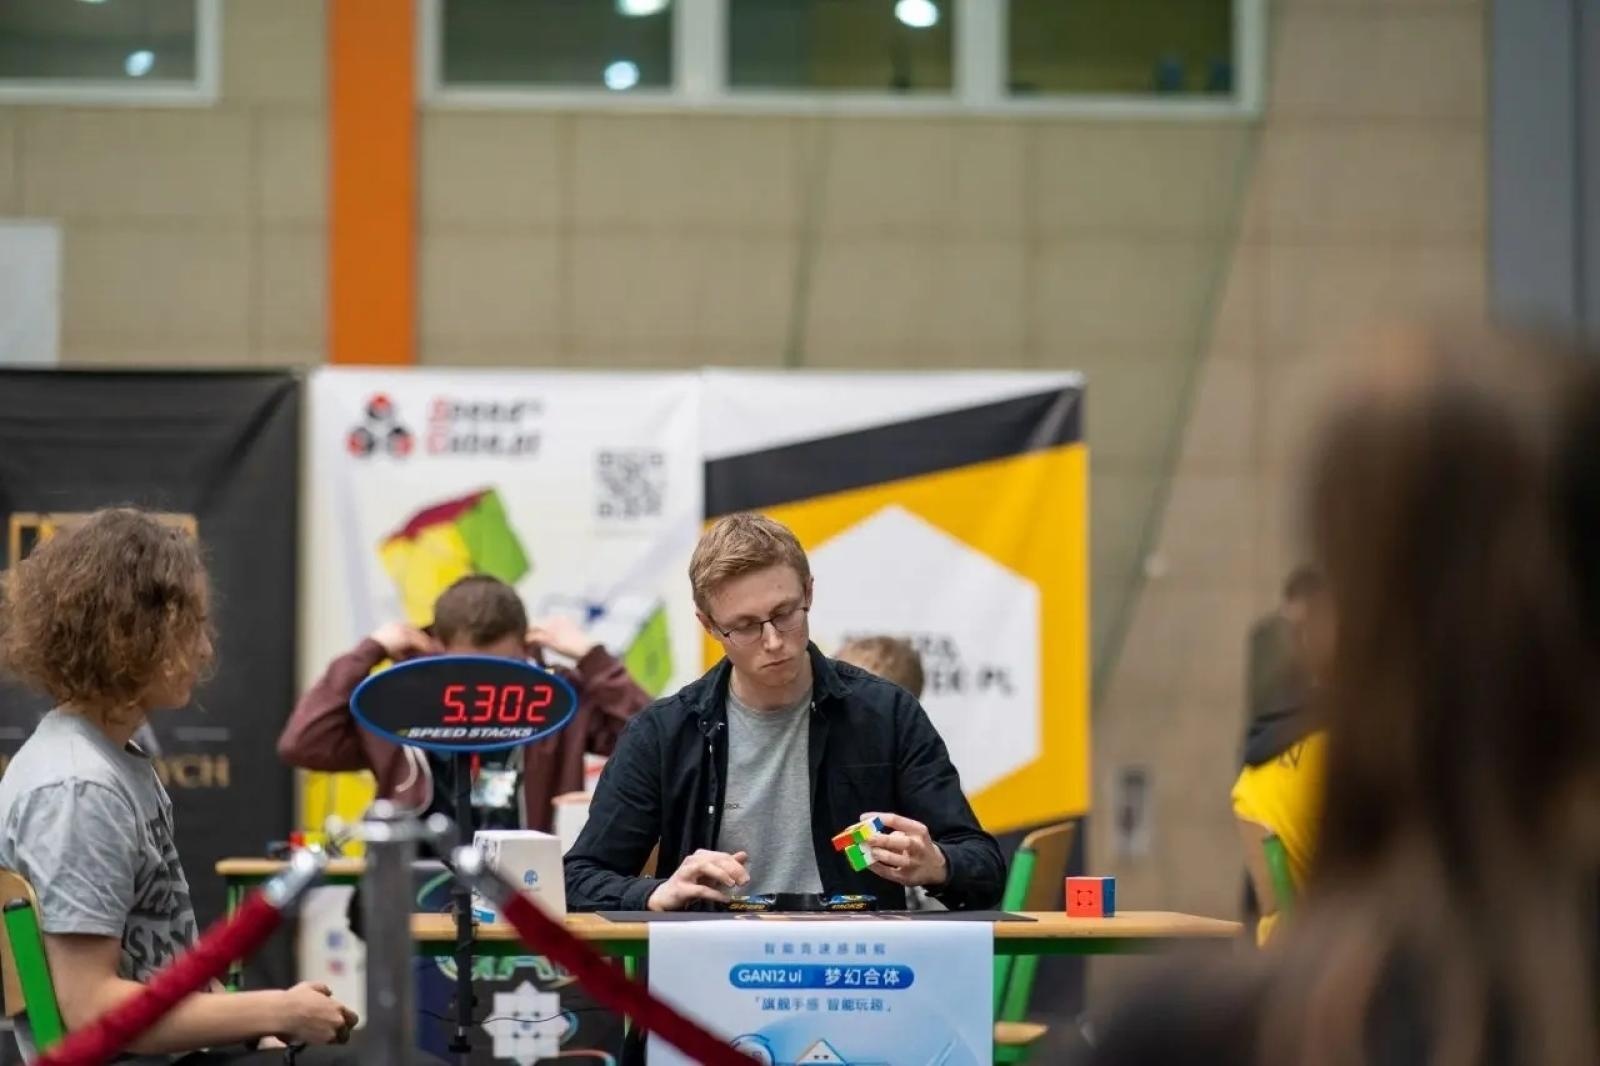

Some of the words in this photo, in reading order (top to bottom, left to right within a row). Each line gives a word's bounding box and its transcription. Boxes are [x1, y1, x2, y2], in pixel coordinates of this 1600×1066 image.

[441, 684, 553, 722] 5.302
[407, 727, 467, 738] SPEED
[468, 727, 532, 738] STACKS
[738, 969, 786, 983] GAN12
[824, 967, 901, 986] 梦幻合体
